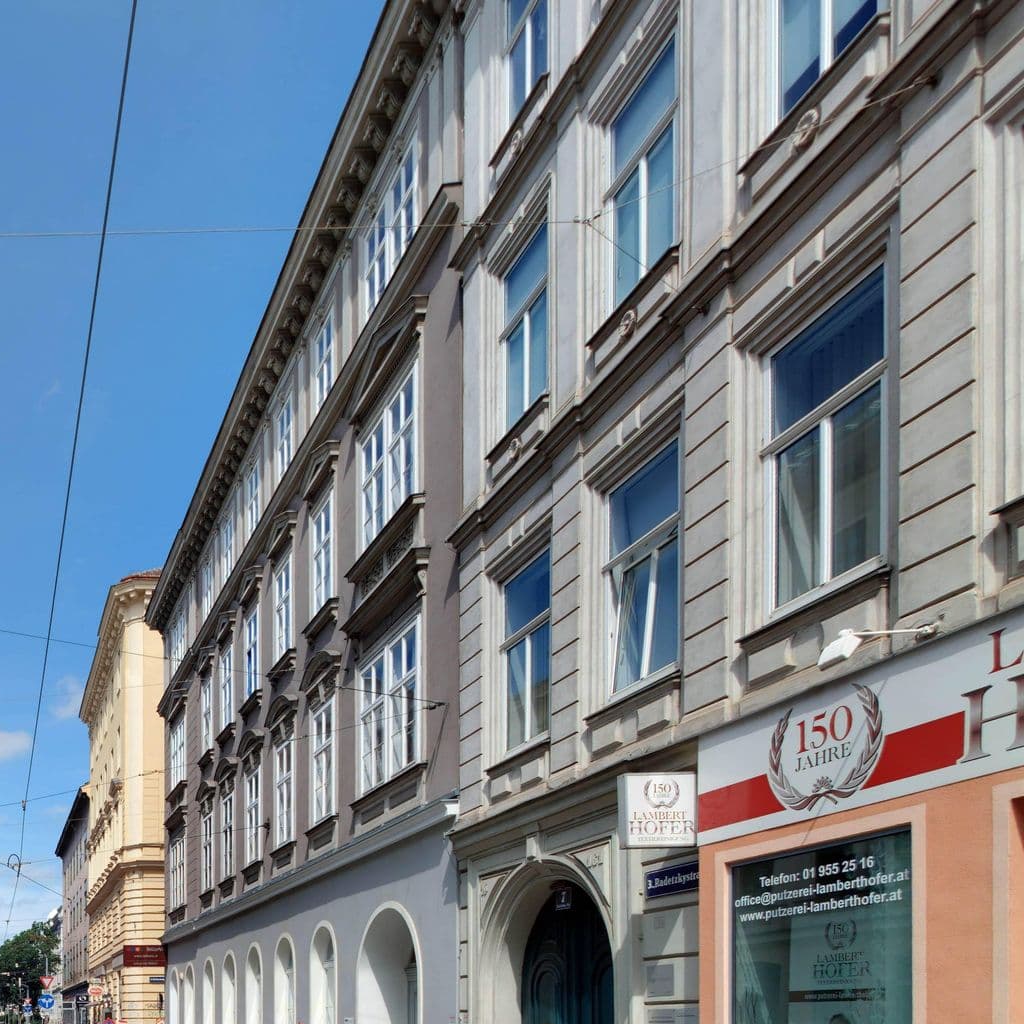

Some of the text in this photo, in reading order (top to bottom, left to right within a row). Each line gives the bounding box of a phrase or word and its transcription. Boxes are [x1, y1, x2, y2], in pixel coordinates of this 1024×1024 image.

[796, 705, 853, 754] 150
[795, 741, 852, 772] JAHRE
[653, 783, 672, 794] 150
[629, 820, 696, 836] HOFER
[633, 810, 688, 821] LAMBERT
[759, 856, 874, 888] Telefon: 01 955 25 16
[734, 868, 910, 908] office@putzerei-lamberthofer.at
[739, 888, 903, 922] www.putzerei-lamberthofer.at
[813, 960, 873, 979] HOFER
